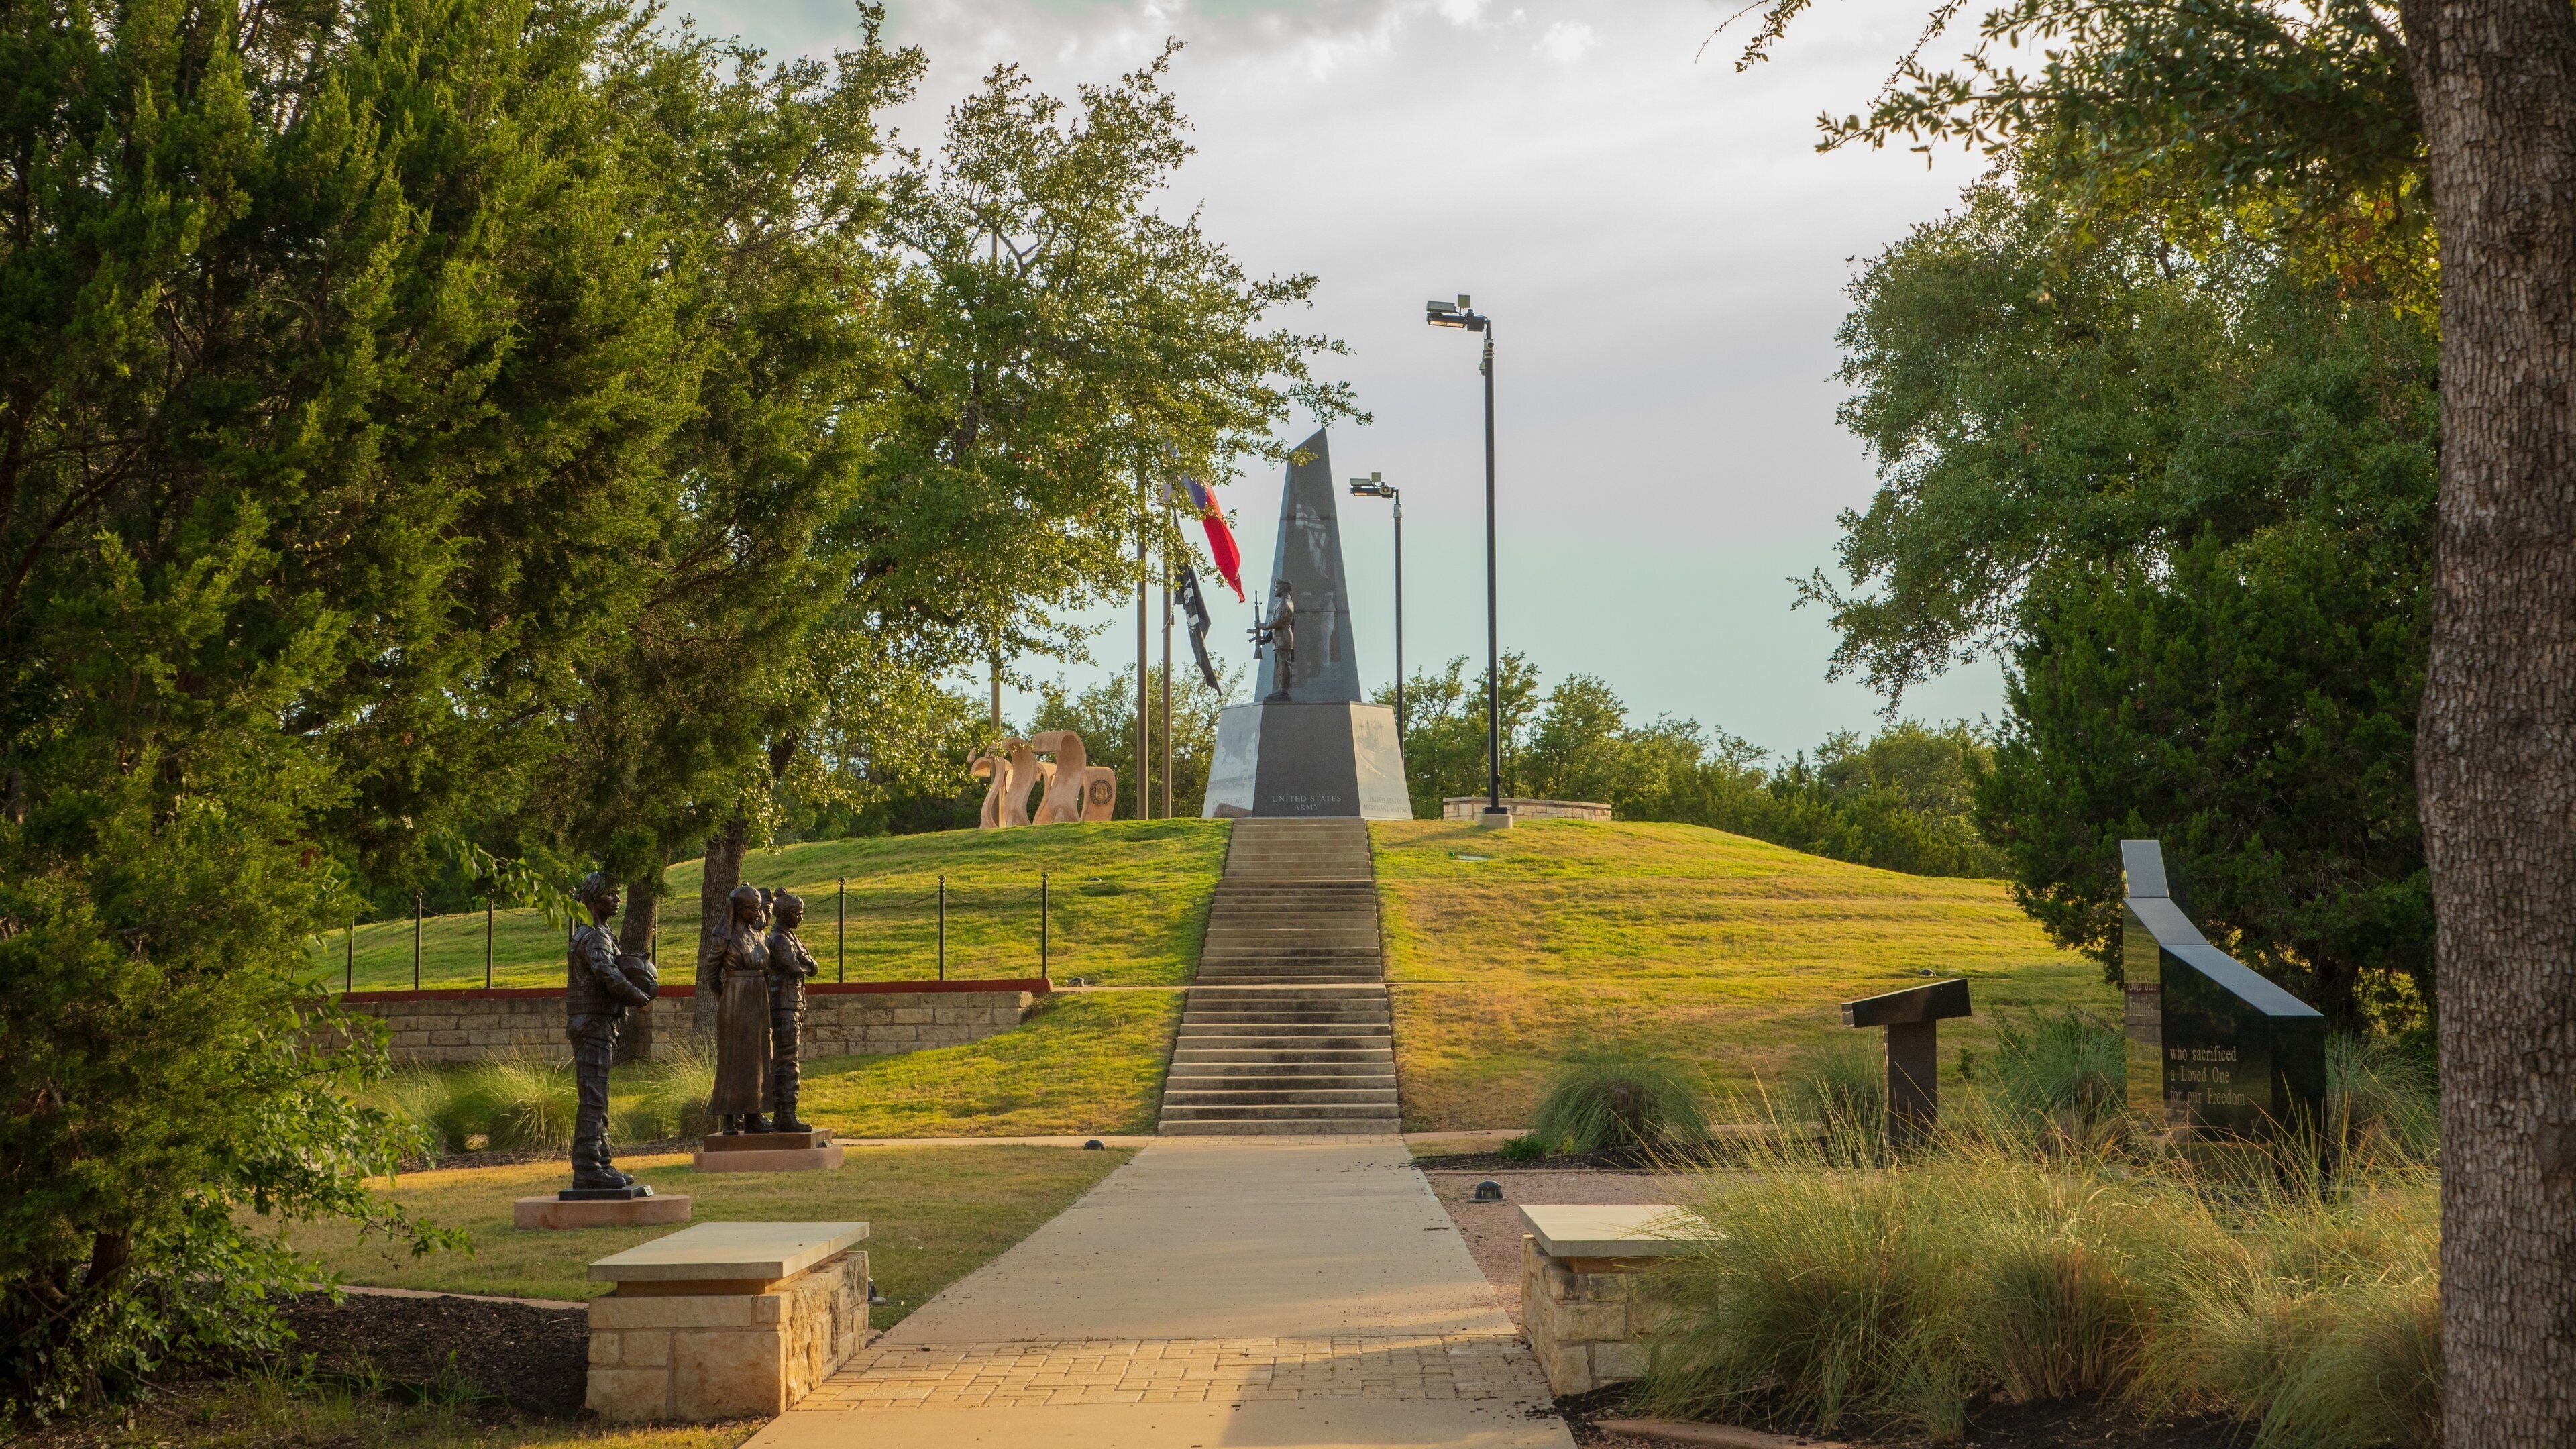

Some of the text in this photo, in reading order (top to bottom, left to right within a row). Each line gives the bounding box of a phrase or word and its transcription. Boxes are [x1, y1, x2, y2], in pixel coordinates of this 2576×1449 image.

[2128, 971, 2157, 991] Gold Star
[2129, 996, 2154, 1016] Families
[2170, 1045, 2187, 1061] who
[2192, 1045, 2237, 1062] sacrificed
[2170, 1065, 2230, 1083] a Loved One
[2170, 1086, 2248, 1106] for our Freedom.
